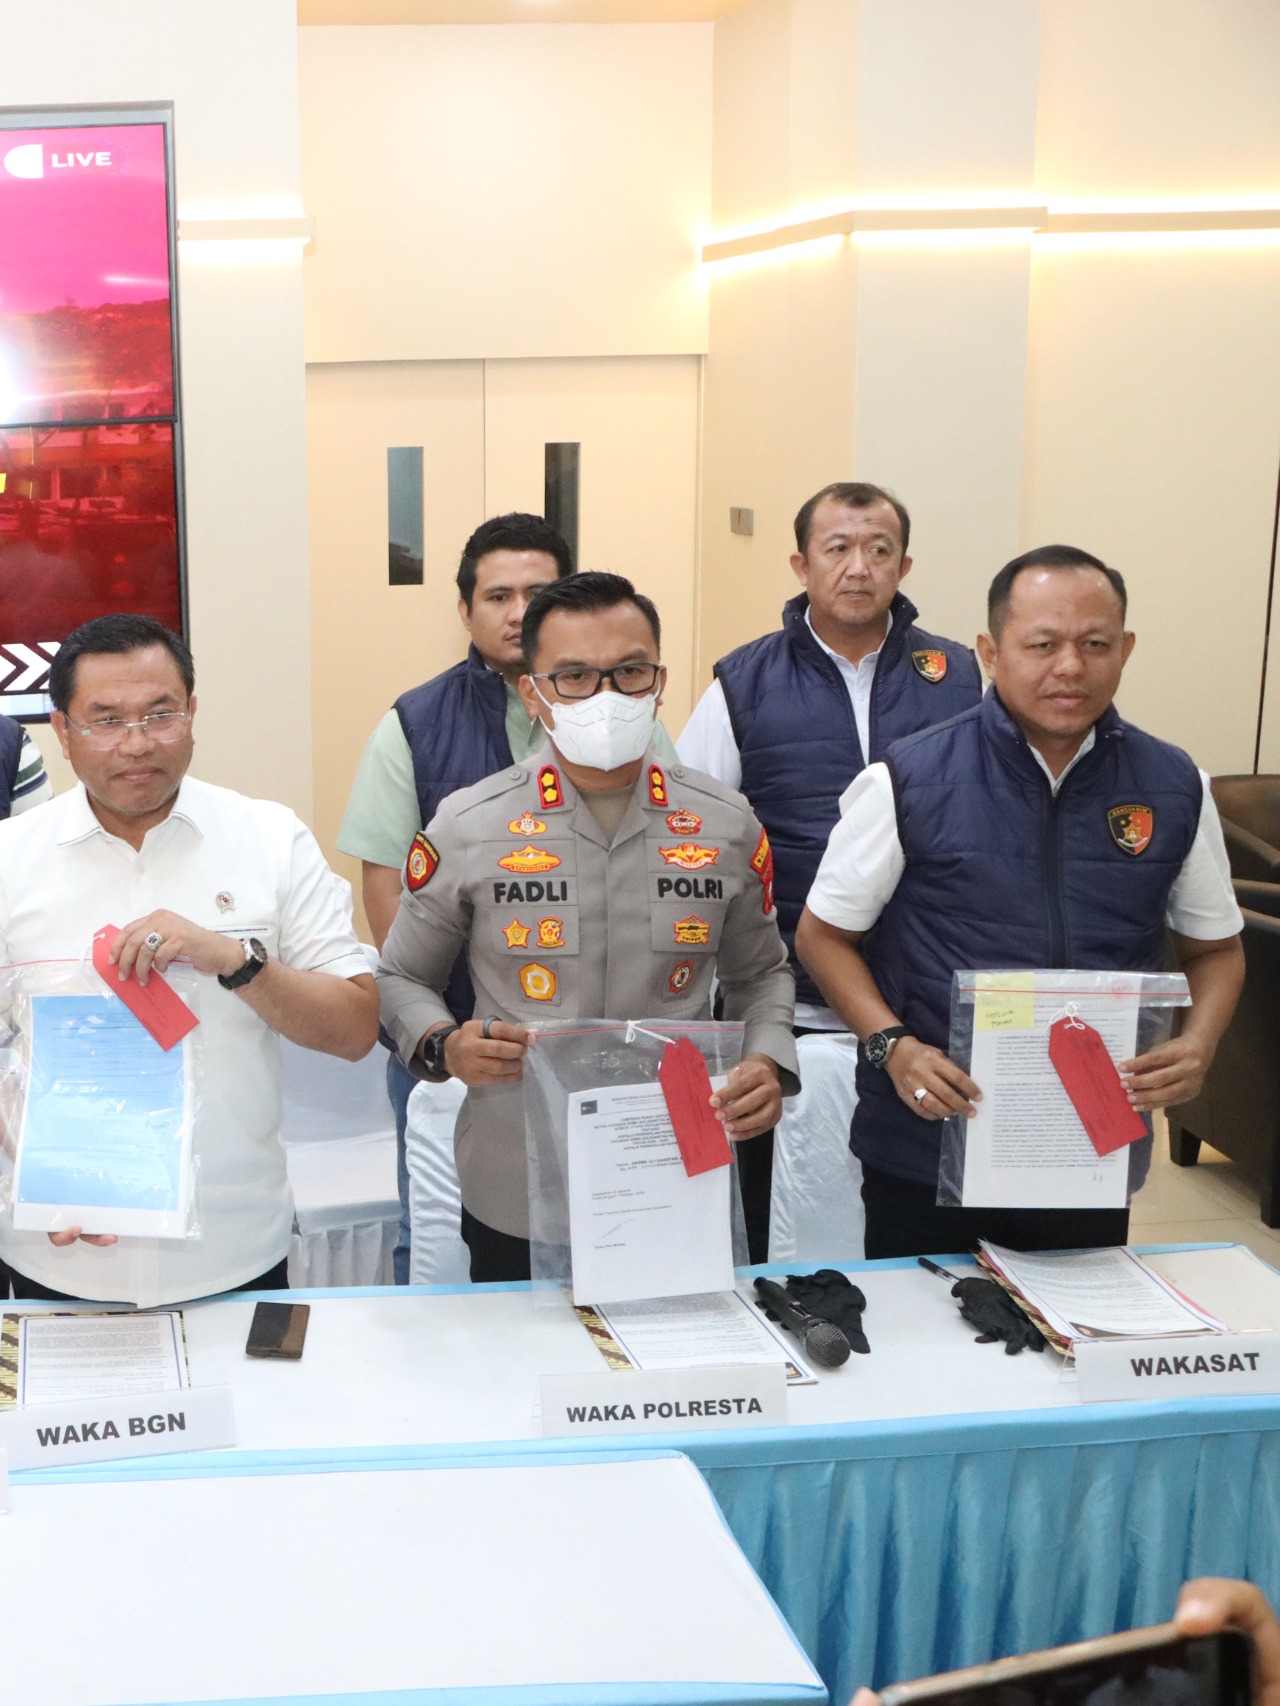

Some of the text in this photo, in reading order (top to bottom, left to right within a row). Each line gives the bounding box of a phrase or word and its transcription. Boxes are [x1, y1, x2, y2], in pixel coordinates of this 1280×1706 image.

[51, 151, 112, 168] LIVE
[493, 880, 568, 903] FADLI
[657, 877, 723, 899] POLRI
[1130, 1353, 1260, 1377] WAKASAT
[566, 1397, 763, 1423] WAKA POLRESTA
[36, 1411, 187, 1448] WAKA BGN
